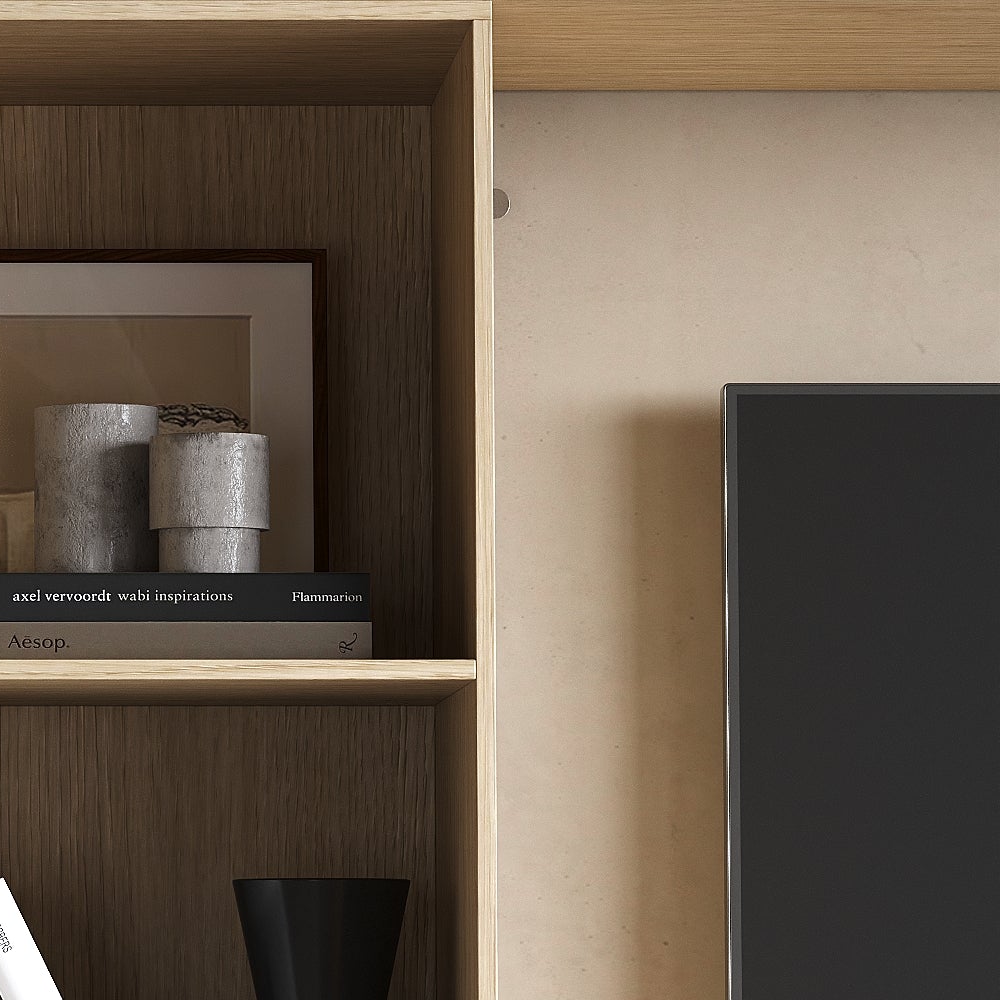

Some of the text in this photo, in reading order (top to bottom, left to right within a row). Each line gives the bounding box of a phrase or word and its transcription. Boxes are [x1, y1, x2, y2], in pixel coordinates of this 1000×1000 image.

[12, 588, 234, 605] axel vervoordt wabi inspirations
[291, 591, 363, 603] Flammarion
